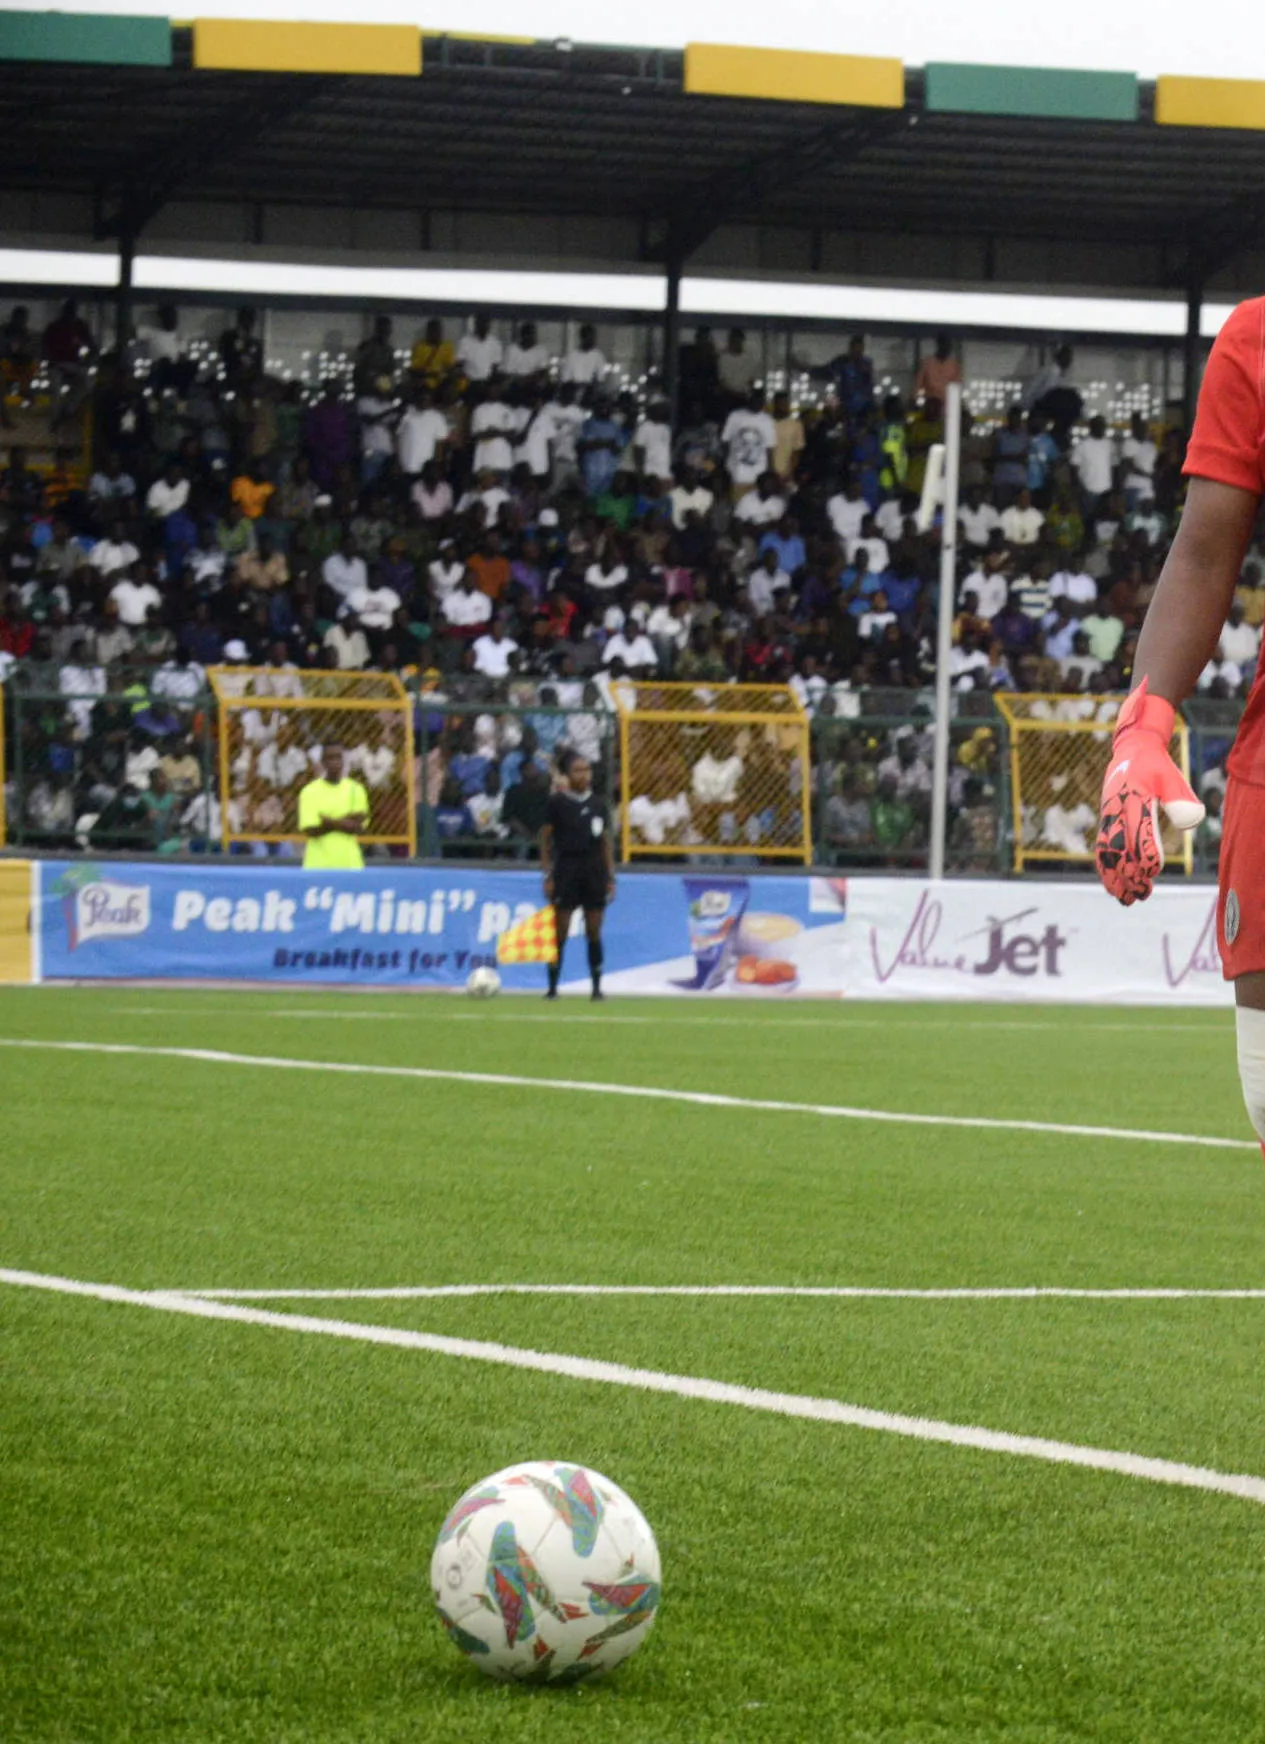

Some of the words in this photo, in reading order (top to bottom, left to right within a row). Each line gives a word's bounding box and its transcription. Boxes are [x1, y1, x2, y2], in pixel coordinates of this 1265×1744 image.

[82, 887, 143, 928] Peak
[172, 889, 297, 932] Peak
[273, 948, 400, 971] Breakfast
[408, 948, 447, 973] for
